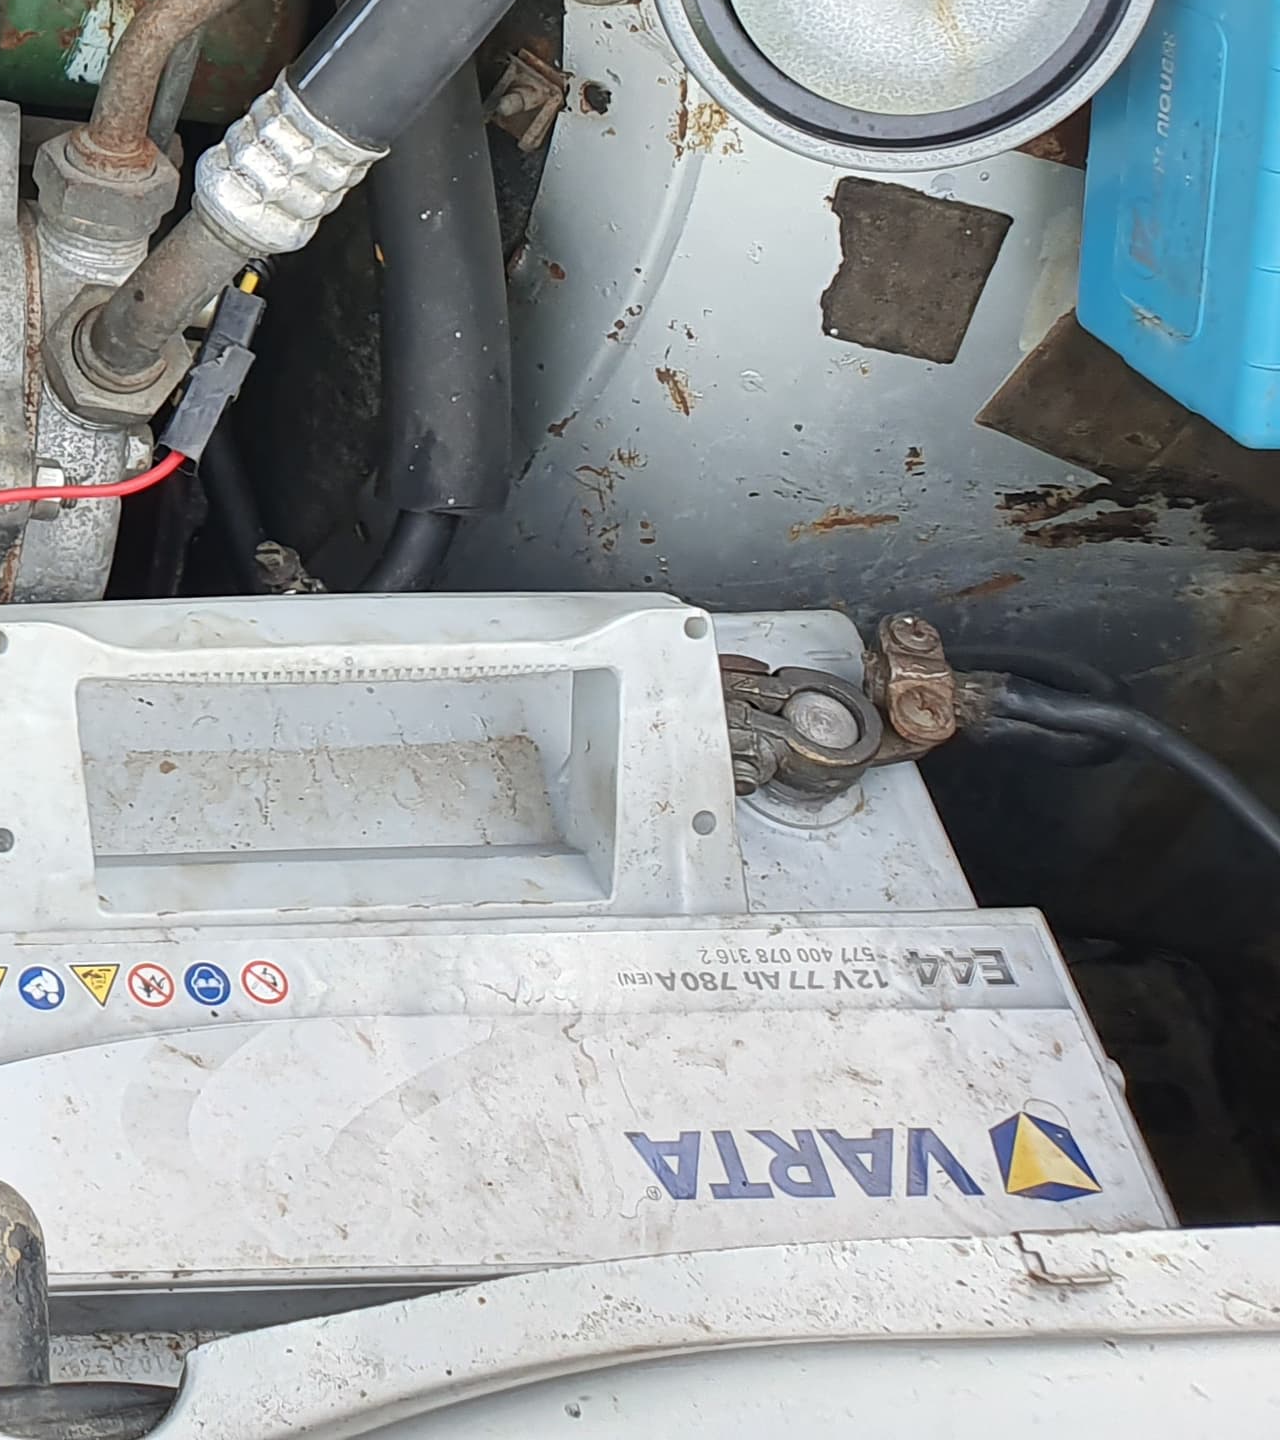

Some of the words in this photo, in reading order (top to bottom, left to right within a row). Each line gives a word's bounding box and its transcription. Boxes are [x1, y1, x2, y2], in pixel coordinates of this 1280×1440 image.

[697, 948, 710, 965] 2
[715, 947, 751, 965] 316
[755, 947, 791, 964] 078
[795, 946, 833, 964] 400
[839, 946, 875, 963] 577
[904, 946, 1019, 988] E44
[742, 970, 782, 990] Ah
[788, 970, 825, 990] 77
[833, 968, 890, 989] 12V
[624, 1127, 986, 1201] VARTA
